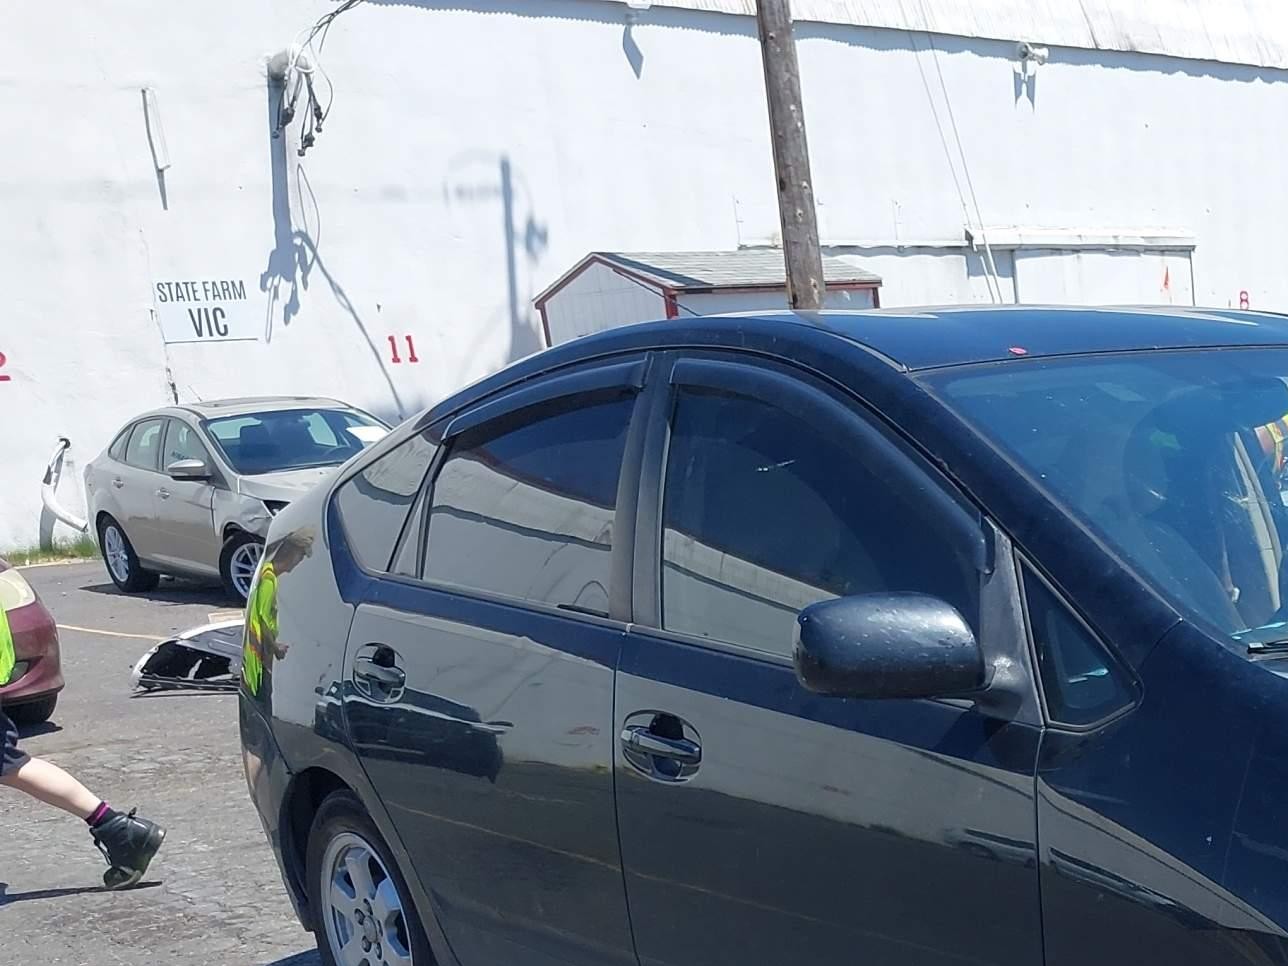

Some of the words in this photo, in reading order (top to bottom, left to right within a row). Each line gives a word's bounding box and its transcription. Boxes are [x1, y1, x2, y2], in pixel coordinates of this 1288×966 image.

[157, 281, 201, 302] STATE
[202, 280, 247, 301] FARM
[1240, 290, 1248, 311] 8
[188, 307, 229, 338] VIC
[388, 335, 419, 363] 11
